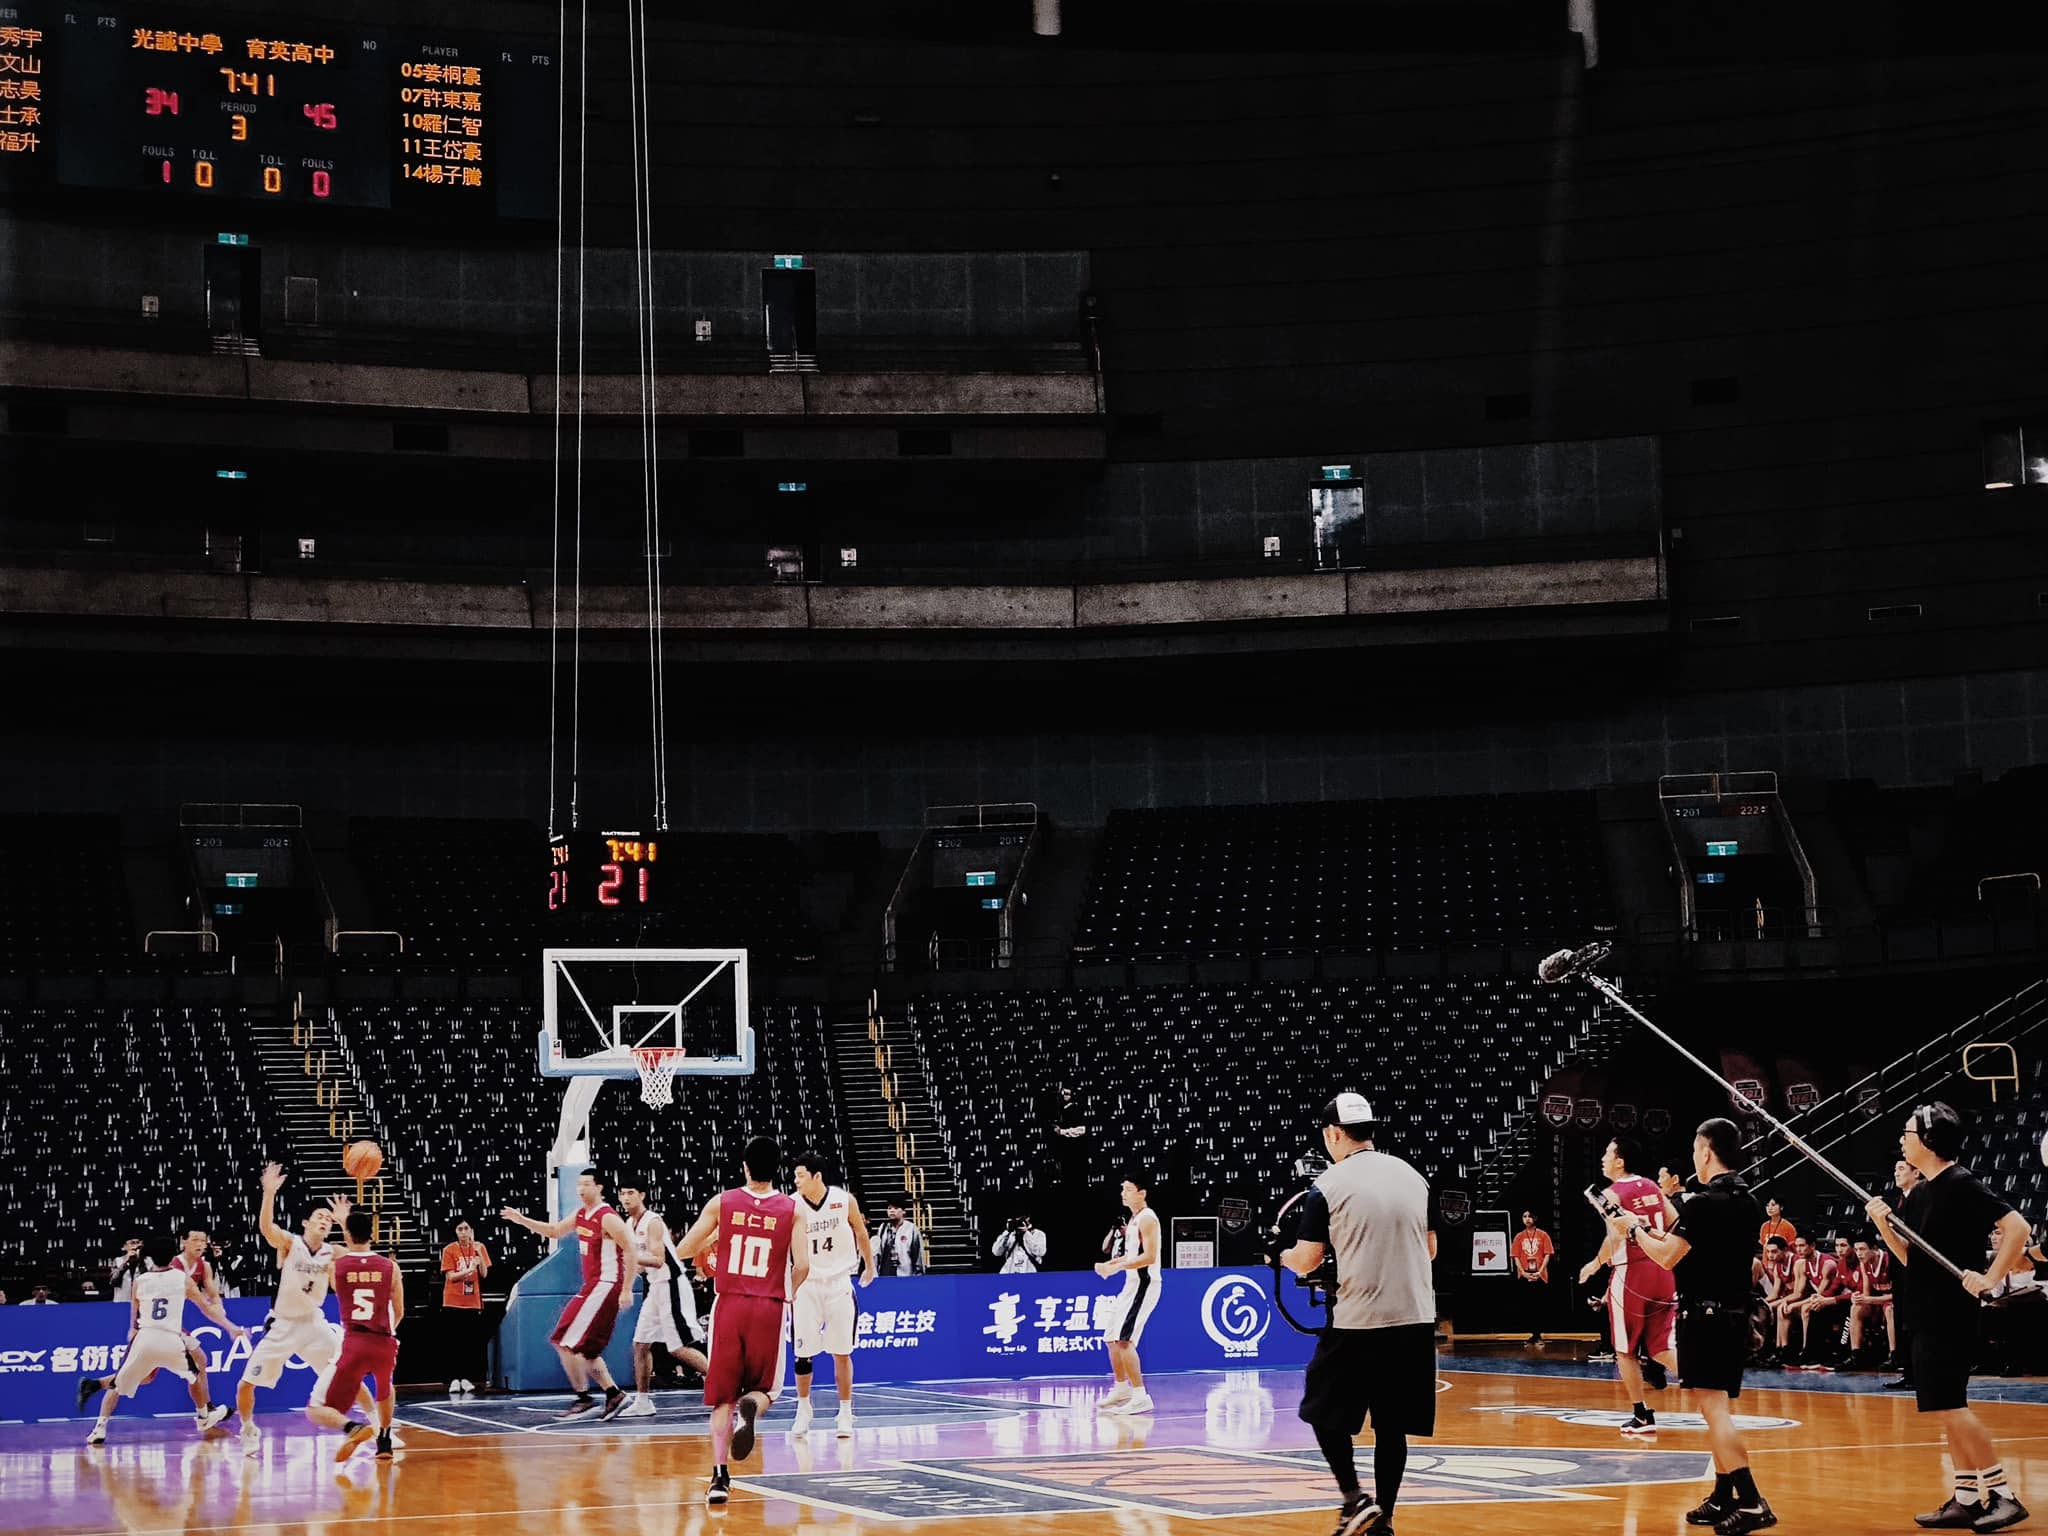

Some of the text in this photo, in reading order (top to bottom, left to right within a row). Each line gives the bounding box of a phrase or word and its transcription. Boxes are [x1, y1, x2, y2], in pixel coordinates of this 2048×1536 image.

[64, 14, 117, 28] FL PTS
[245, 38, 335, 65] 育英高中
[362, 40, 377, 50] NO
[422, 45, 459, 57] PLAYER
[531, 55, 550, 66] PTS
[219, 67, 275, 97] 7:41
[145, 87, 179, 116] 34
[220, 101, 257, 114] PERIOD
[231, 114, 247, 141] 3
[303, 102, 337, 131] 45
[142, 145, 175, 158] FOULS
[301, 158, 334, 170] FOULS
[162, 160, 213, 188] 1 0
[263, 166, 330, 198] 0 0
[606, 839, 657, 862] 7:41
[548, 870, 569, 910] 21
[598, 864, 650, 906] 21
[727, 1233, 772, 1278] 10
[811, 1237, 833, 1254] 14
[151, 1297, 168, 1320] 6
[351, 1288, 375, 1320] 5
